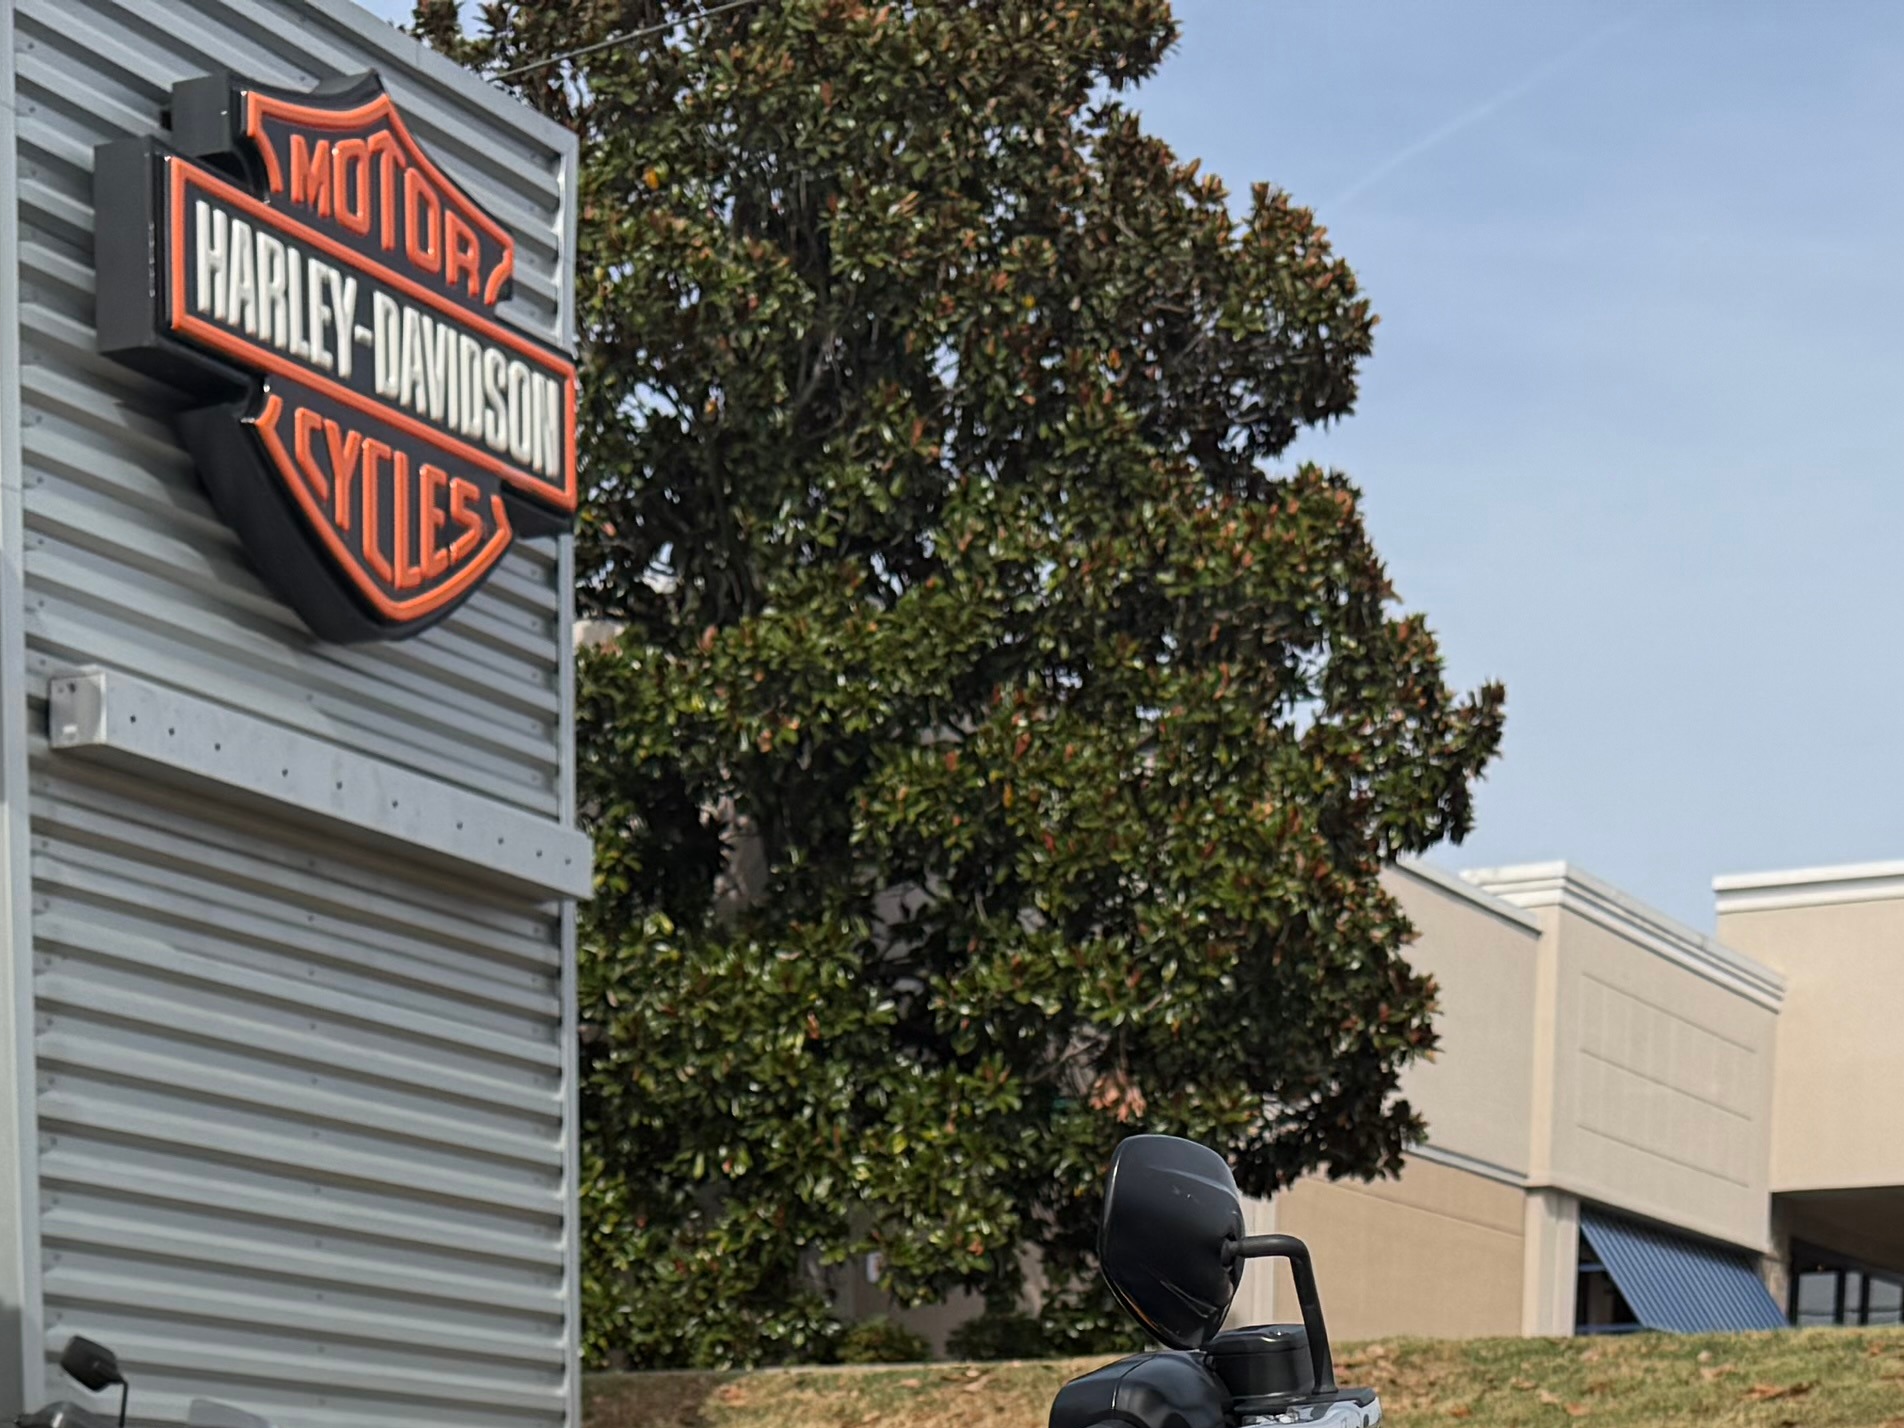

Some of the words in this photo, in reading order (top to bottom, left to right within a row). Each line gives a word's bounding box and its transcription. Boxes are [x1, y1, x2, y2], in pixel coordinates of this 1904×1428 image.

[290, 131, 482, 298] MOTOR
[195, 199, 561, 479] HARLEY-DAVIDSON
[295, 406, 484, 590] CYCLES
